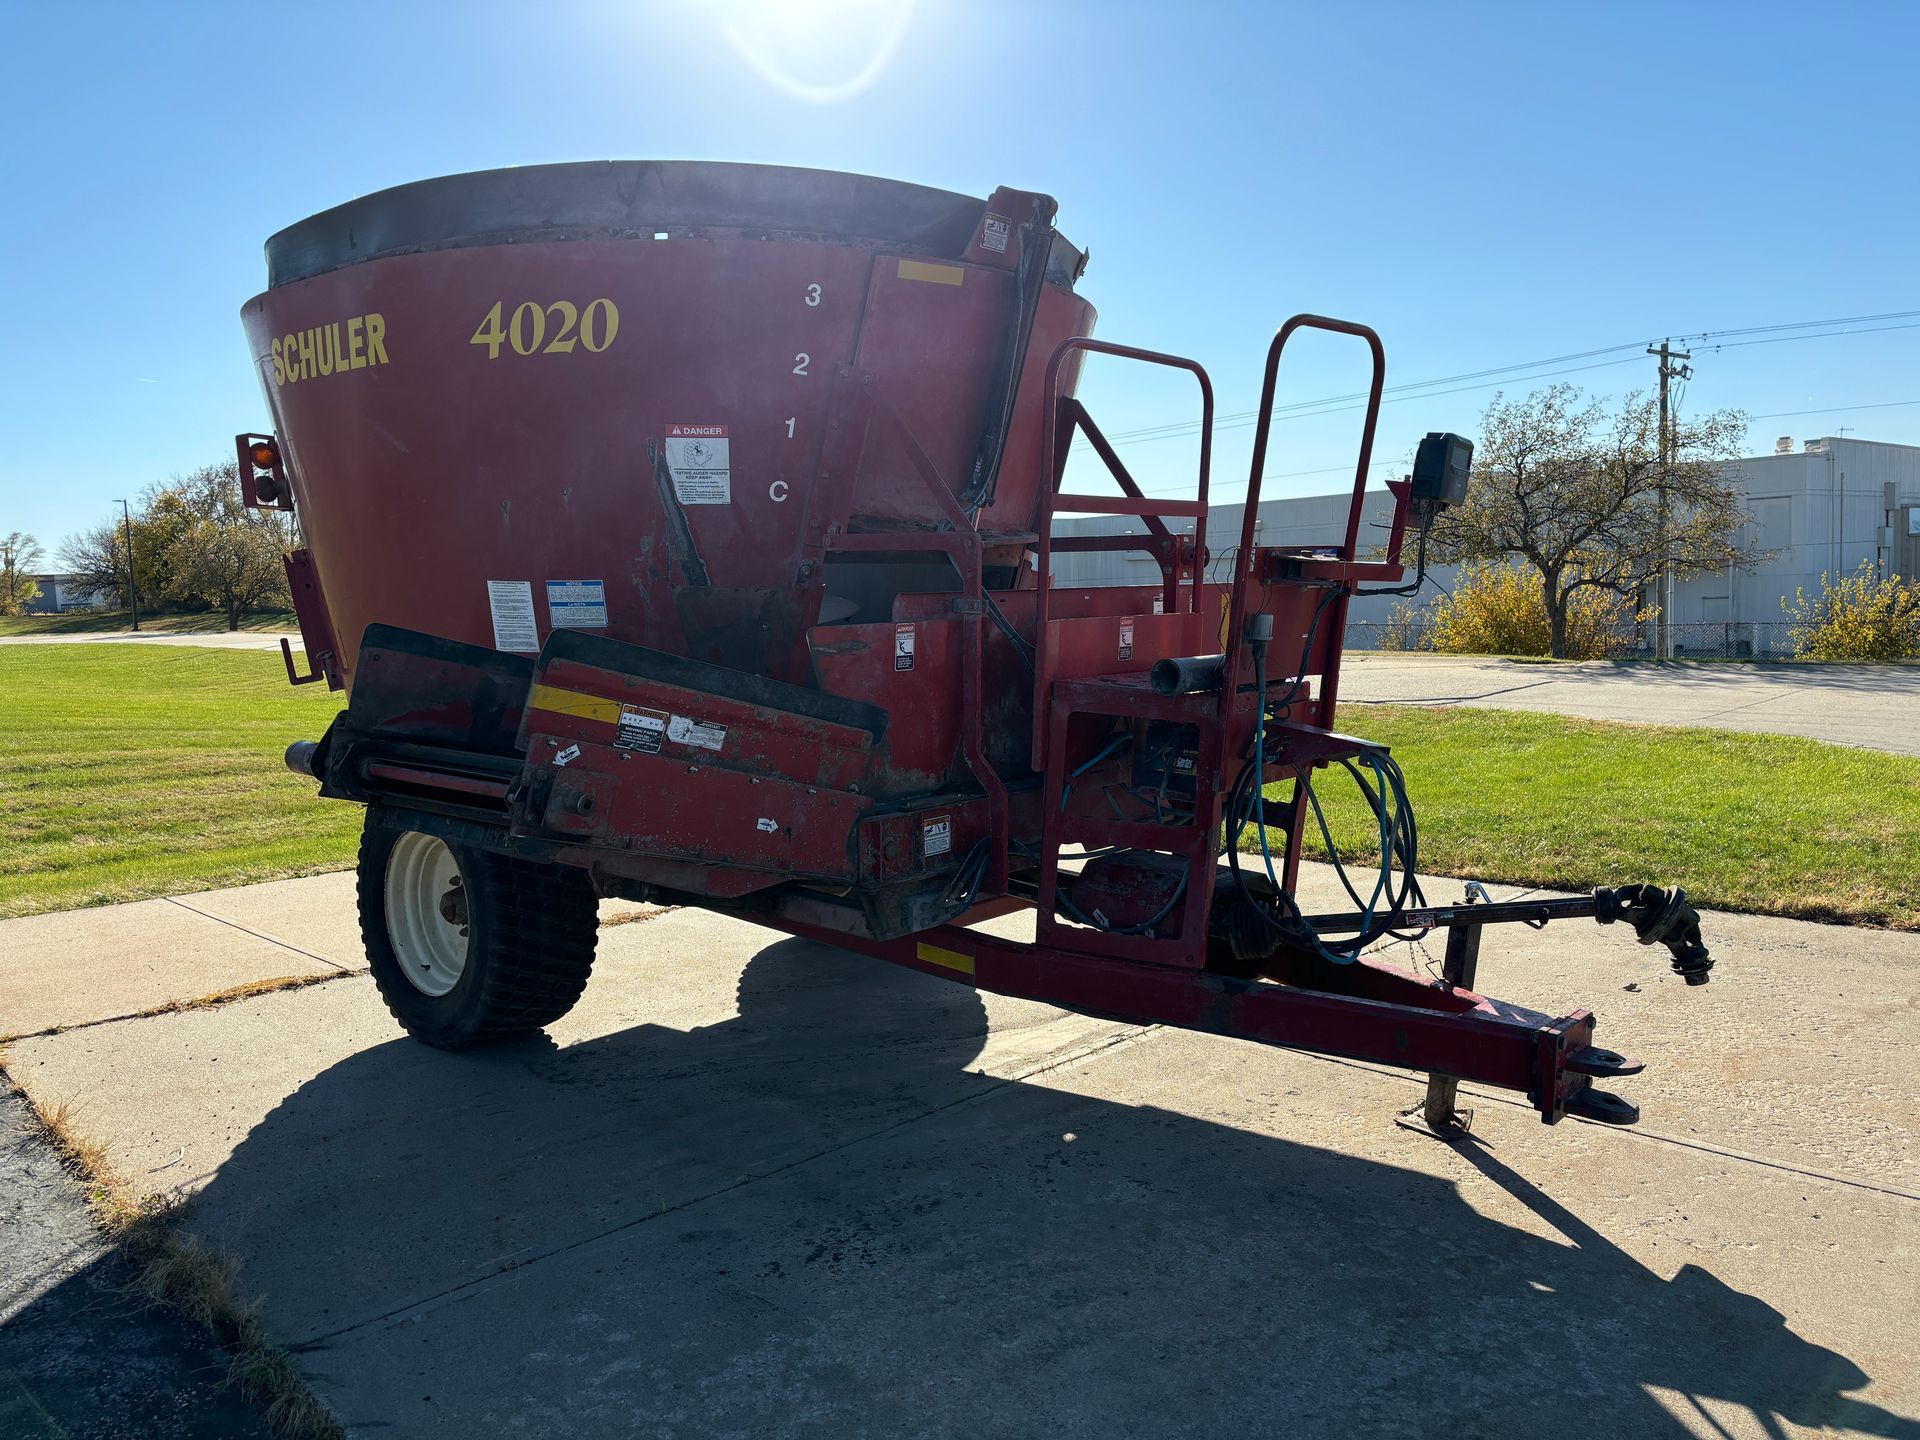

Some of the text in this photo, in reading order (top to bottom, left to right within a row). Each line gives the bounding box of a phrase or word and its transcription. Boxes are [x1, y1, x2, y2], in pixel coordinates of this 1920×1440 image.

[804, 283, 822, 307] 3
[470, 298, 619, 360] 4020
[271, 313, 390, 386] SCHULER
[792, 352, 810, 376] 2
[683, 427, 722, 435] DANGER
[785, 417, 796, 439] 1
[769, 480, 789, 502] C
